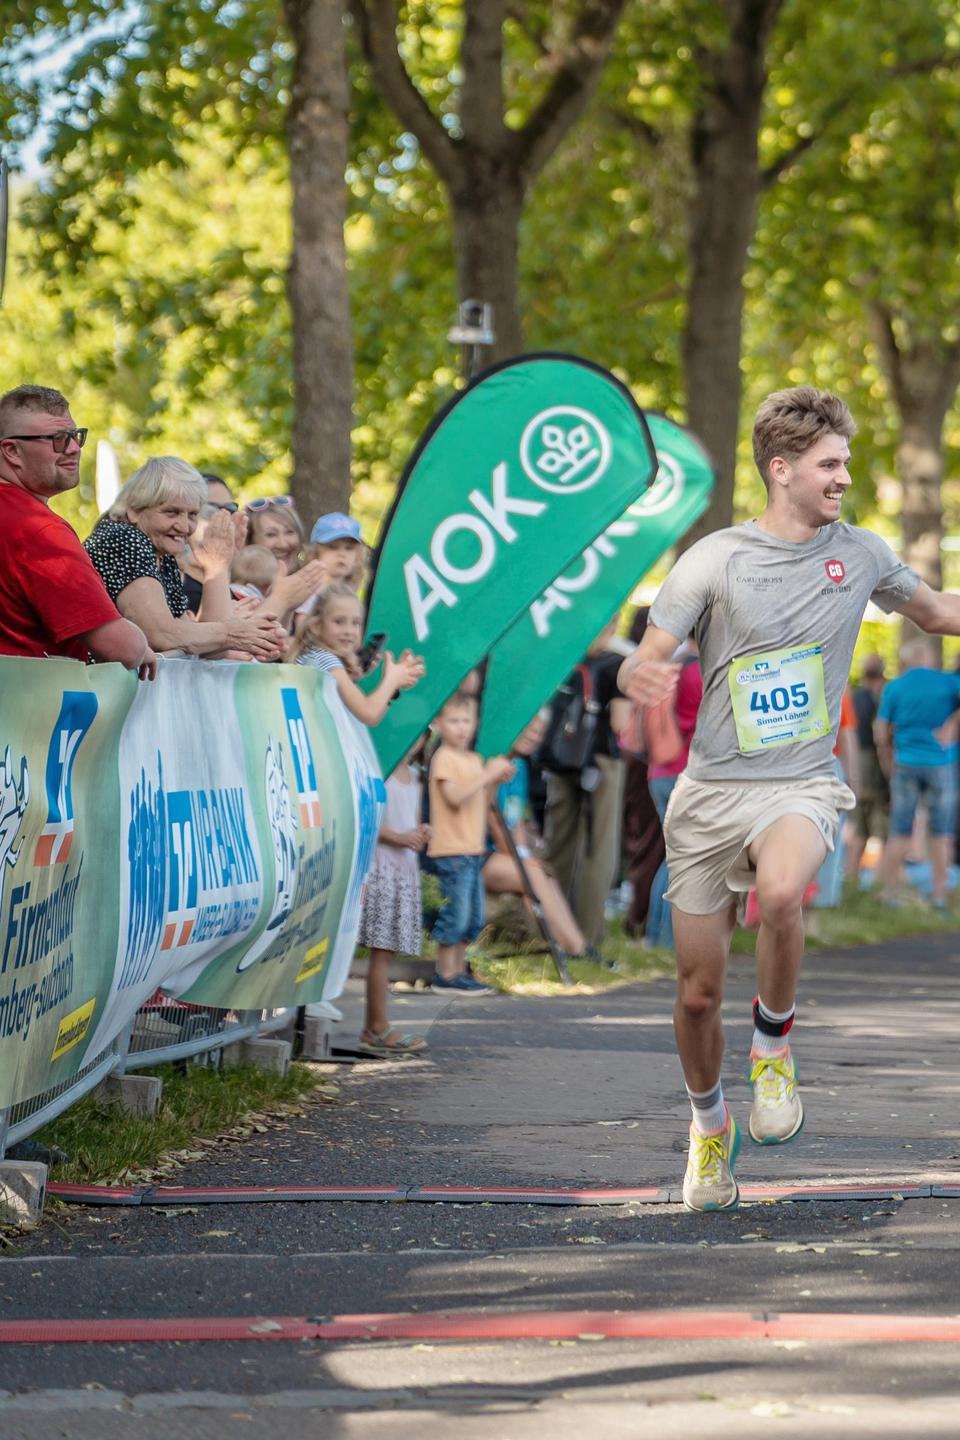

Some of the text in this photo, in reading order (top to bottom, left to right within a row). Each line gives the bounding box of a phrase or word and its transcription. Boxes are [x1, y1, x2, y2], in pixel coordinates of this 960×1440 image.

[403, 461, 548, 642] AOK
[828, 564, 843, 577] CG
[750, 682, 809, 714] 405
[757, 716, 783, 727] Simon
[784, 709, 810, 721] Löhner
[209, 787, 260, 888] BANK
[1, 850, 85, 974] Firmenlauf
